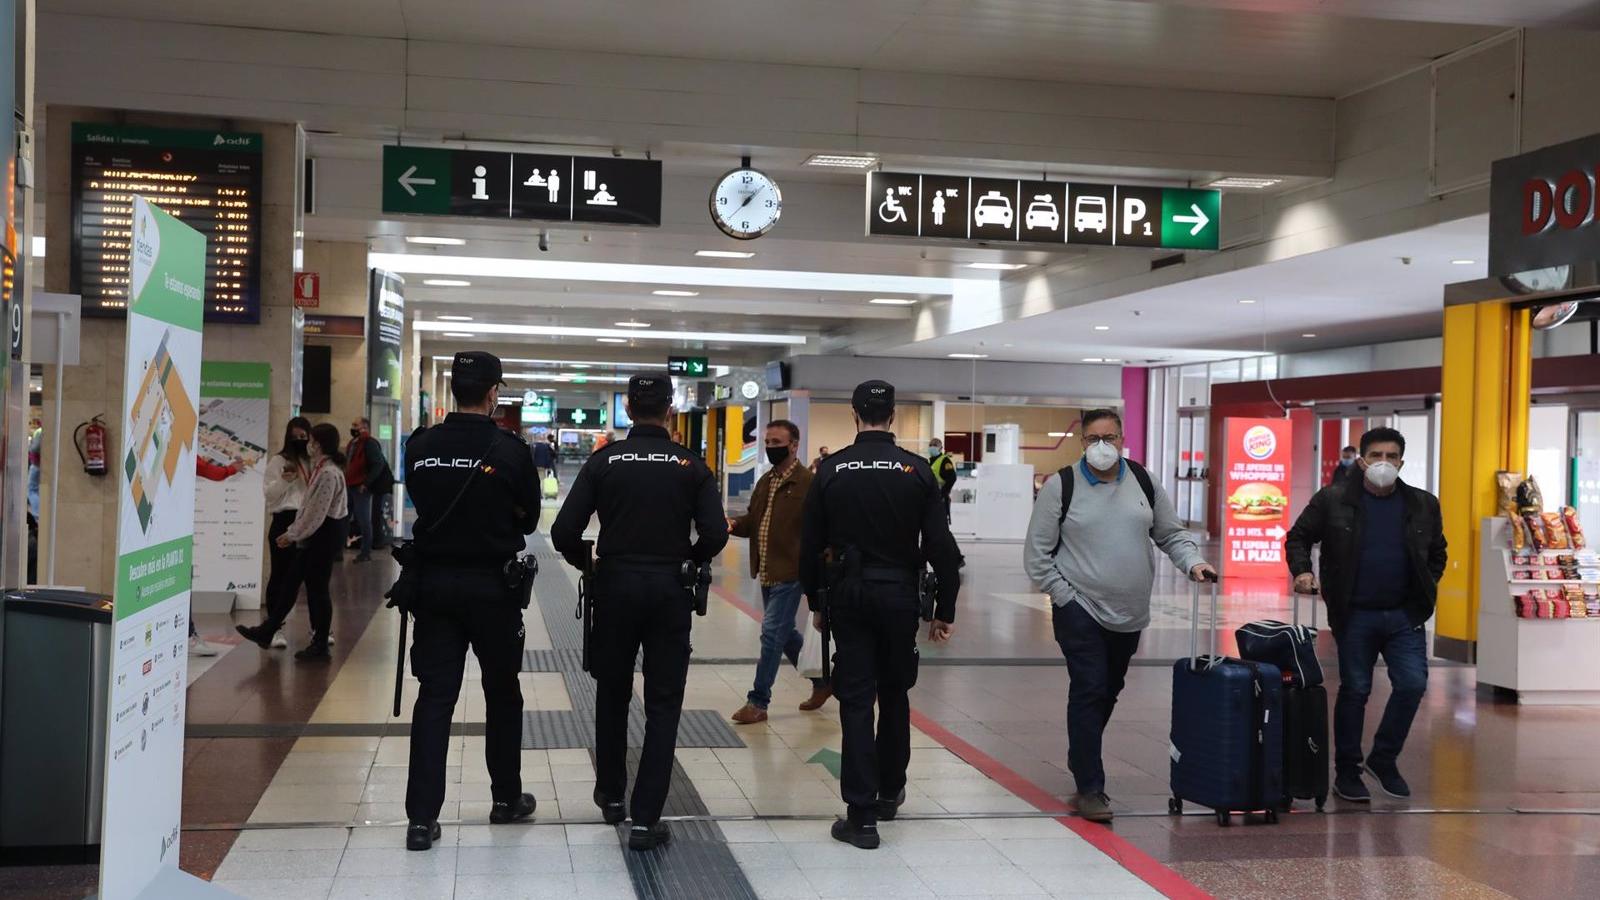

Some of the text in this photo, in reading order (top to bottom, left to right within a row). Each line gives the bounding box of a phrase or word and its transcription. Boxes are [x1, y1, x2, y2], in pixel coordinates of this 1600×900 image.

[742, 176, 753, 184] 12
[898, 186, 912, 197] WC
[946, 188, 959, 198] WC
[720, 197, 728, 205] 9
[1521, 161, 1600, 236] DO
[765, 200, 773, 208] 3
[741, 221, 749, 229] 6
[12, 303, 21, 348] 9
[1249, 438, 1272, 451] KING
[608, 453, 680, 464] POLICIA
[835, 461, 904, 473] POLICIA
[1228, 527, 1235, 537] A
[1232, 540, 1281, 550] TE ESPERA EN
[1231, 549, 1281, 562] LA PLAZA
